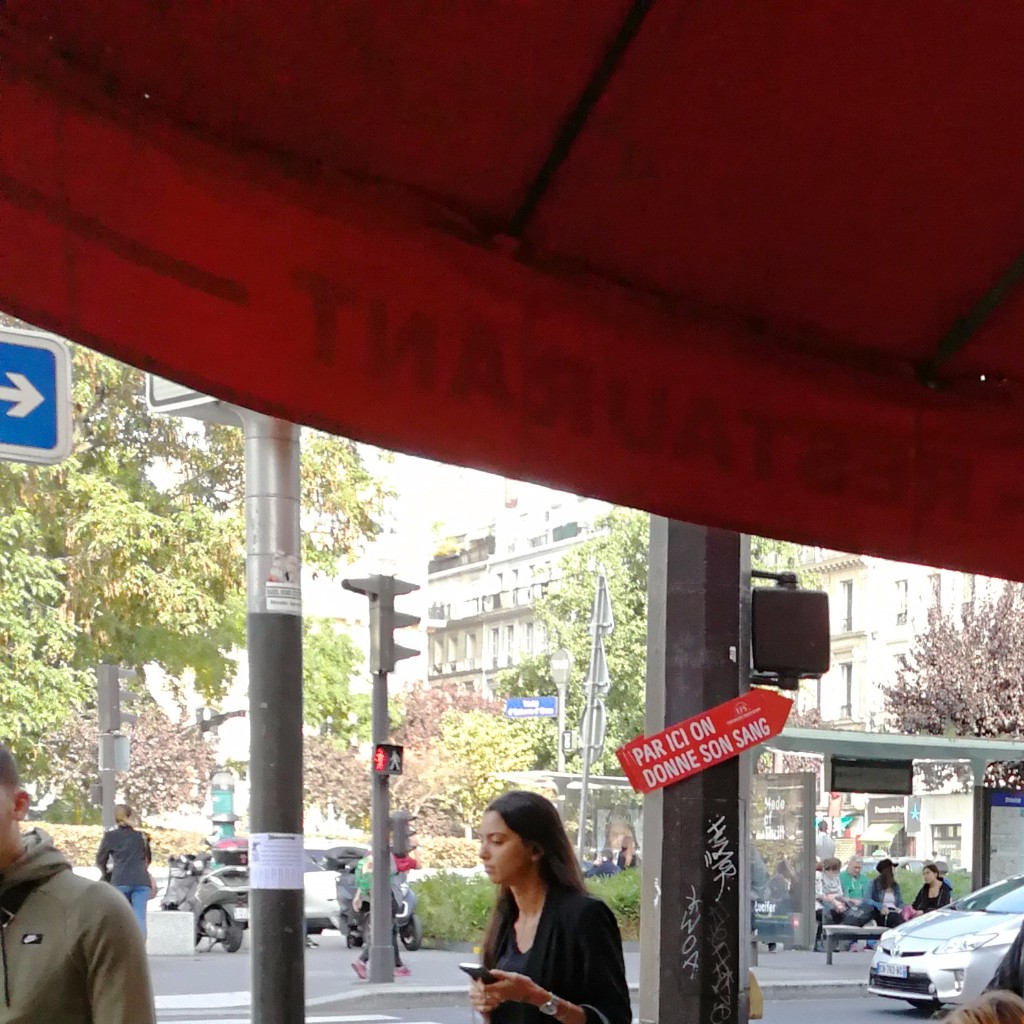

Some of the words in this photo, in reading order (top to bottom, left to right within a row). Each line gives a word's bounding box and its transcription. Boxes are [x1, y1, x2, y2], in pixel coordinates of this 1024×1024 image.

[632, 738, 668, 767] PAR
[665, 728, 690, 753] ICI
[690, 716, 716, 741] ON
[642, 749, 701, 788] DONNE
[699, 734, 734, 763] SON
[732, 717, 771, 748] SANG
